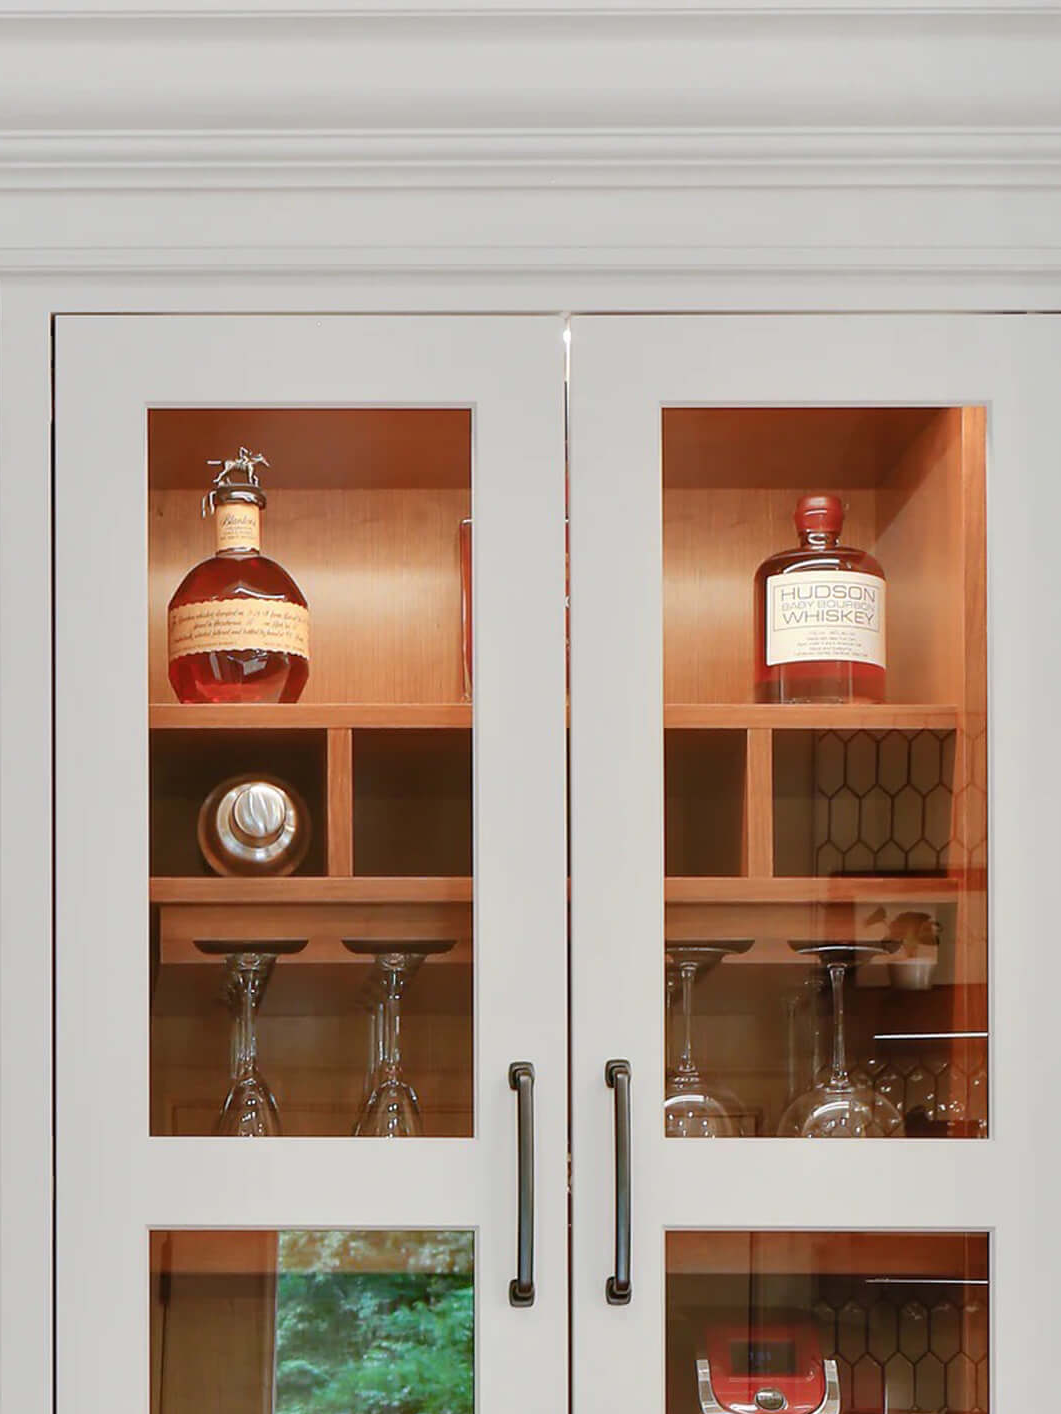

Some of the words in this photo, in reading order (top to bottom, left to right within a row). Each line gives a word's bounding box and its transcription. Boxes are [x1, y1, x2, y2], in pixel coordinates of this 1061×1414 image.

[780, 585, 875, 602] HUDSON
[781, 601, 815, 611] BABY
[817, 600, 875, 612] BOURBON
[783, 609, 875, 624] WHISKEY
